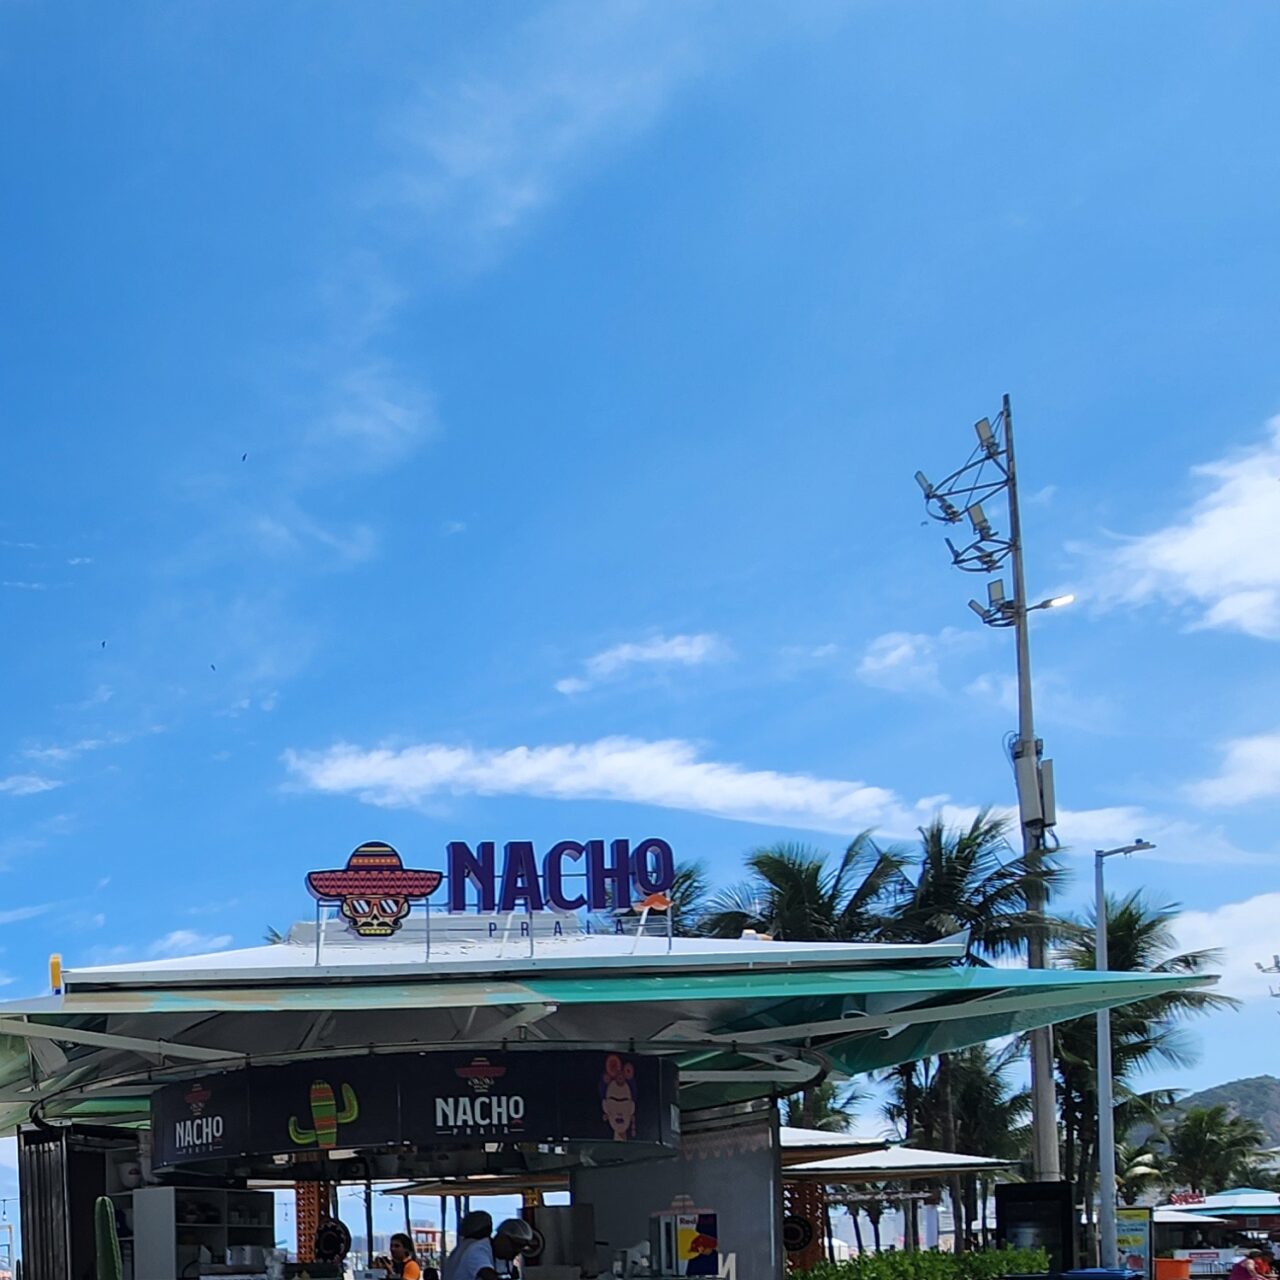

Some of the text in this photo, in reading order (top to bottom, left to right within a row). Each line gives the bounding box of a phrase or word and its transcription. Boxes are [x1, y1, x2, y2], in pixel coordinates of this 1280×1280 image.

[446, 838, 674, 914] NACHO
[488, 919, 625, 938] PRAIA
[435, 1095, 525, 1127] NACHO
[175, 1115, 224, 1149] NACHO
